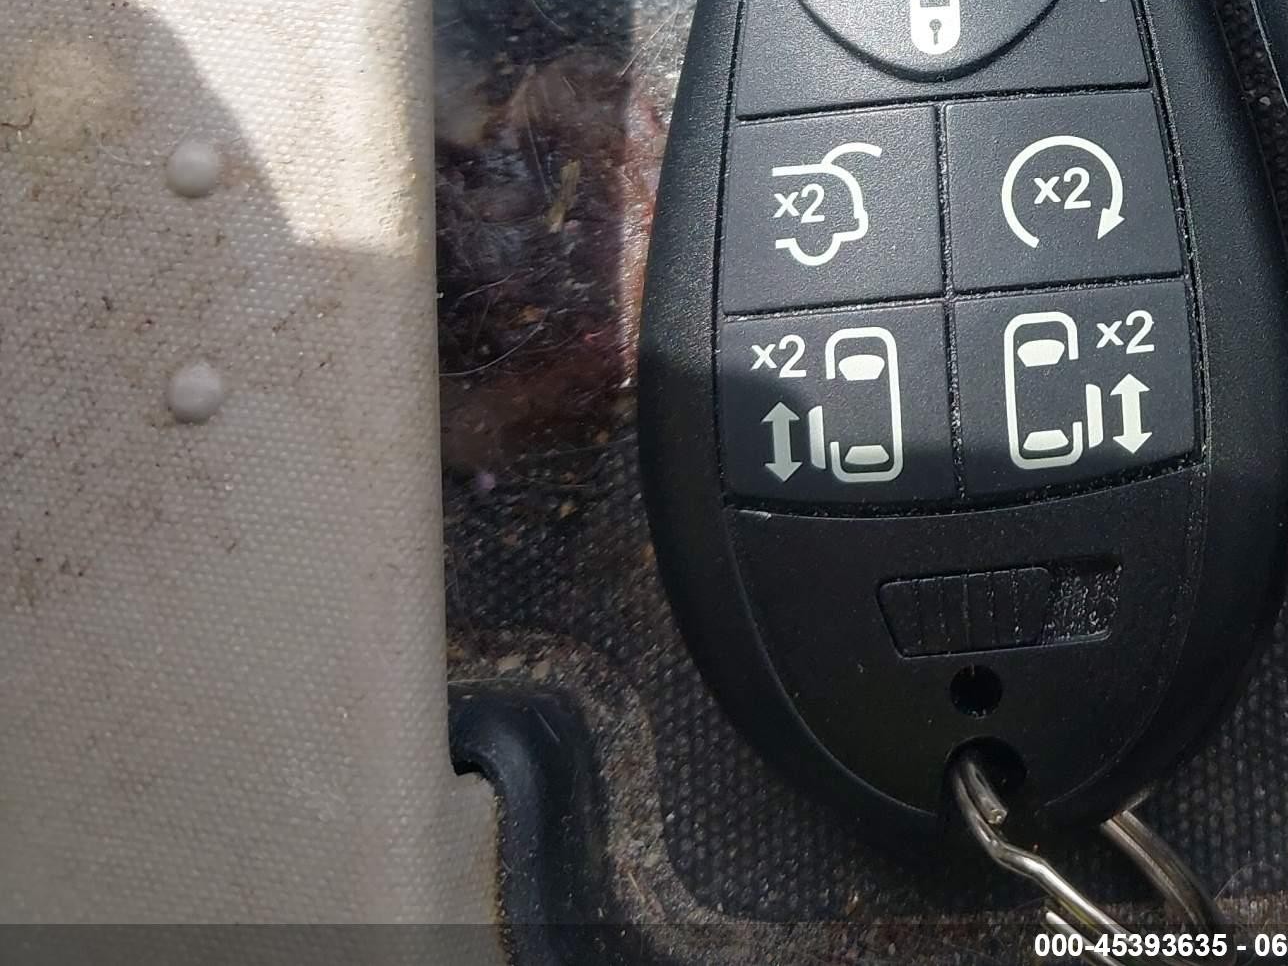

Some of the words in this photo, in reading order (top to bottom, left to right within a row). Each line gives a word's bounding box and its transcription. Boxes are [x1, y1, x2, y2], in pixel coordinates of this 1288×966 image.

[772, 182, 828, 227] x2
[1033, 166, 1092, 210] x2
[1095, 310, 1155, 355] x2
[751, 334, 808, 378] x2
